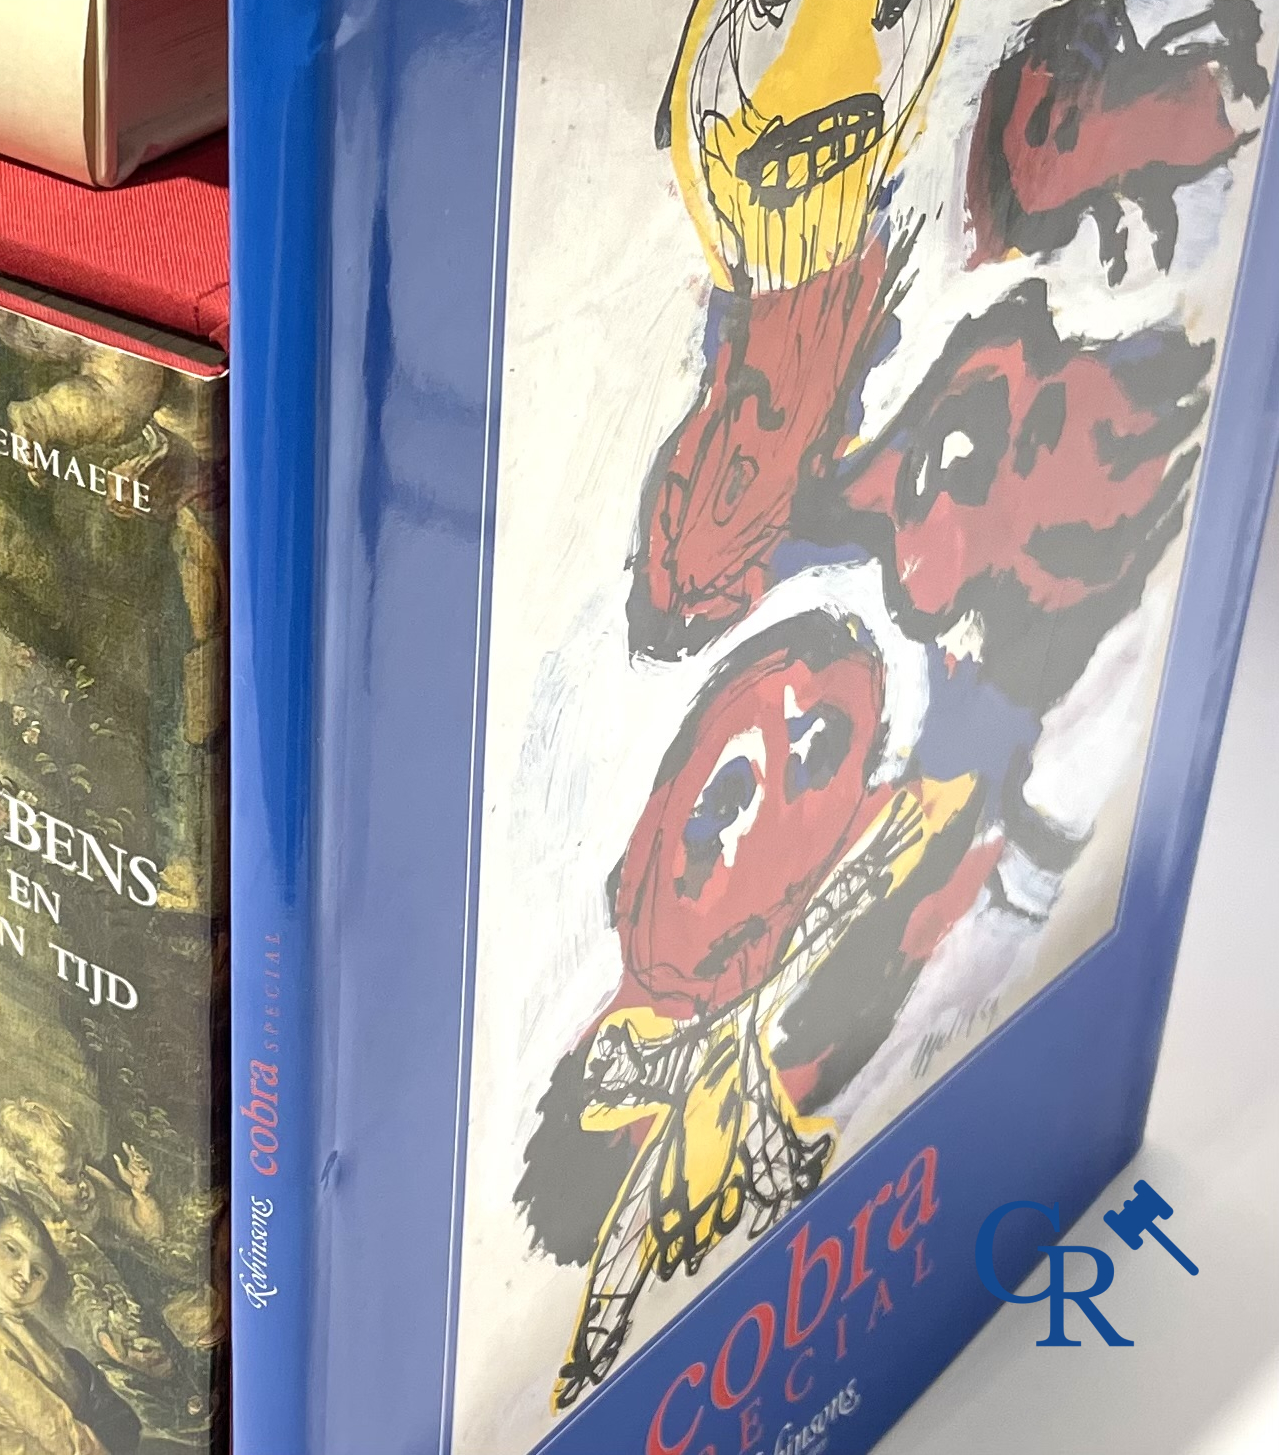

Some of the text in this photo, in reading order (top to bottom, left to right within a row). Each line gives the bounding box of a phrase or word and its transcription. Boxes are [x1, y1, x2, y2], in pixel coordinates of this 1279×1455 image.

[7, 868, 62, 926] EN
[47, 943, 139, 1011] TIJD
[238, 932, 282, 1310] Robinsons cobra SPECIAL
[645, 1146, 939, 1455] cobra
